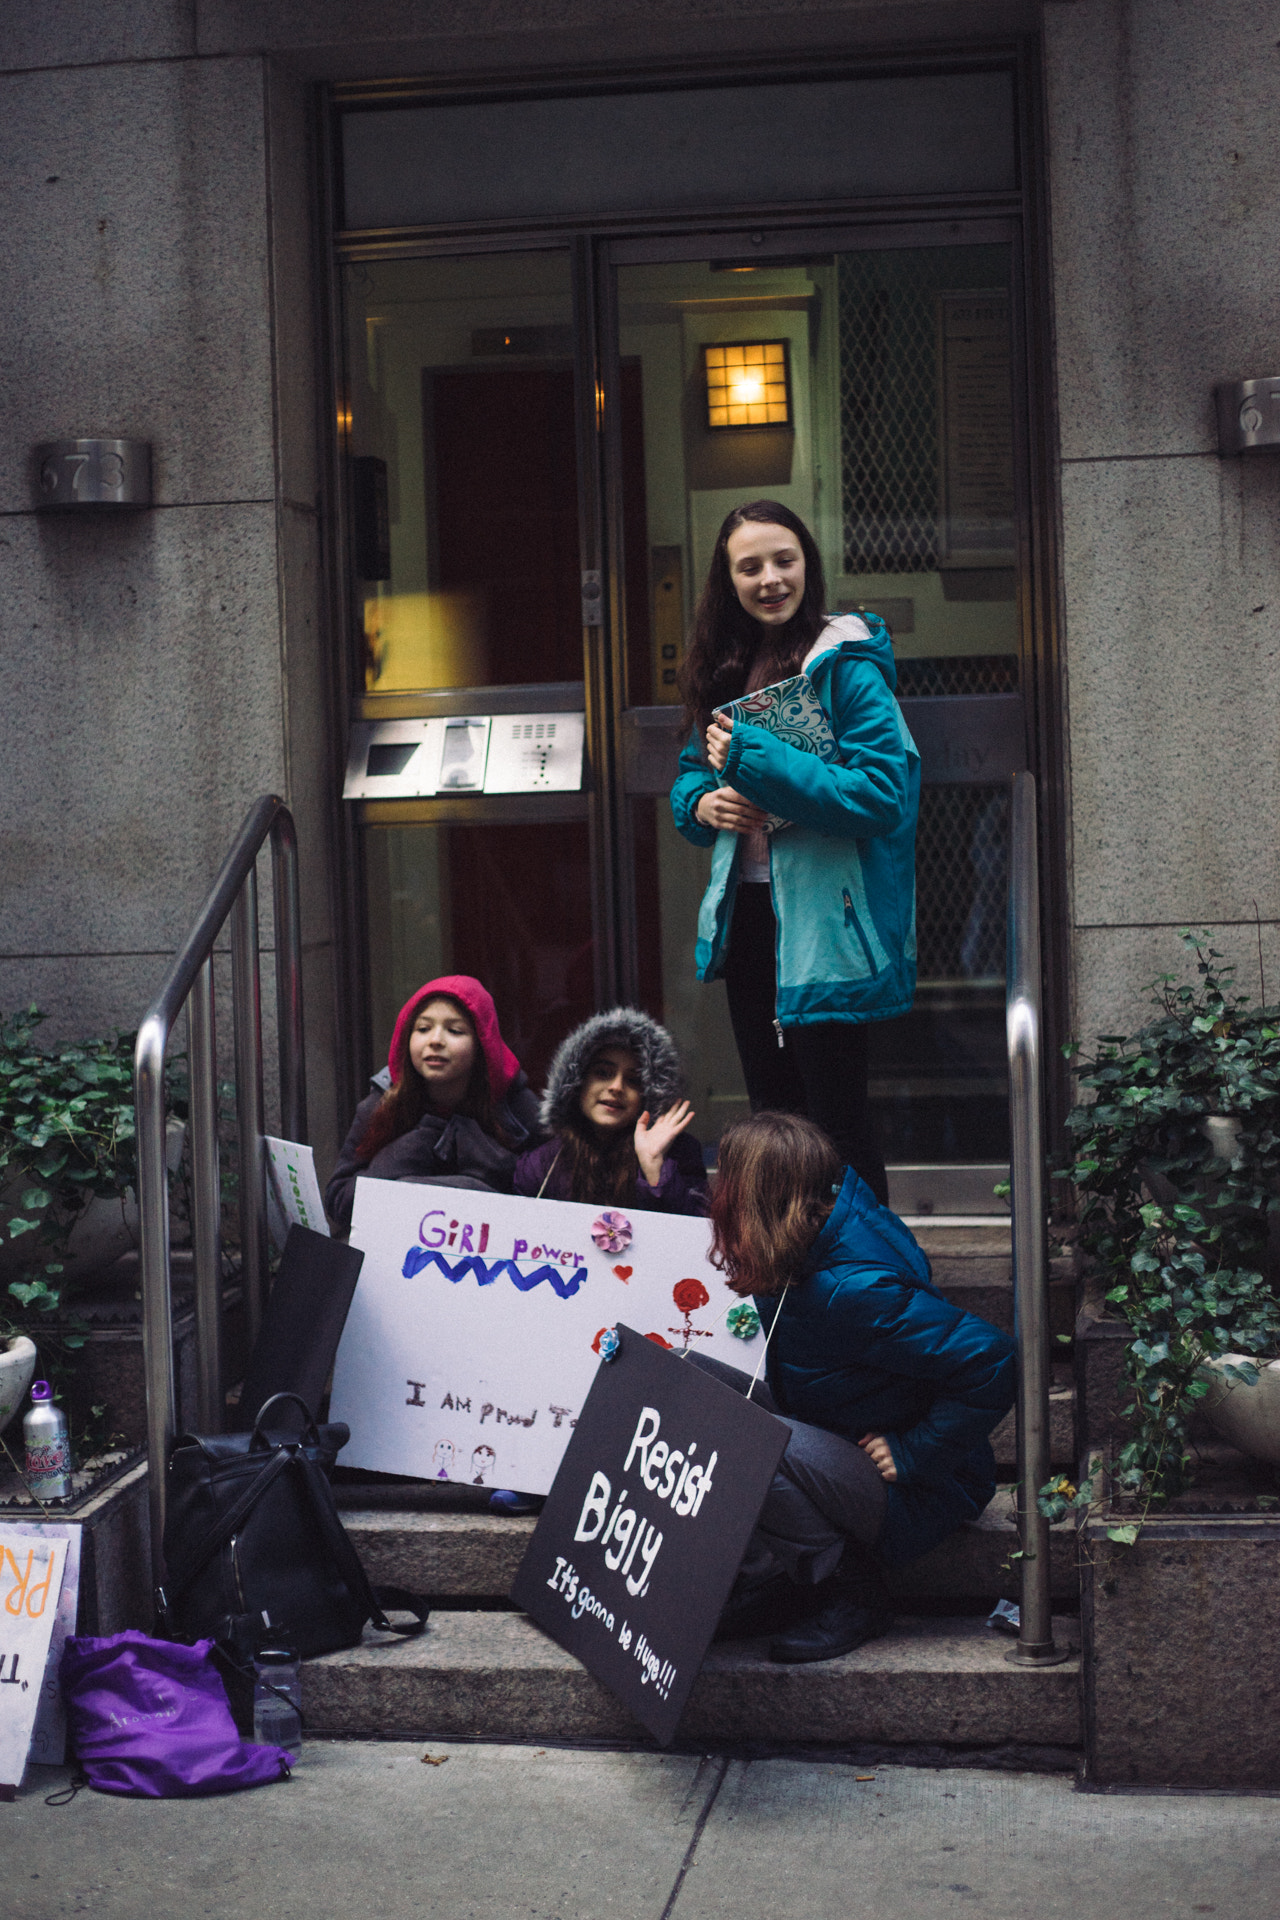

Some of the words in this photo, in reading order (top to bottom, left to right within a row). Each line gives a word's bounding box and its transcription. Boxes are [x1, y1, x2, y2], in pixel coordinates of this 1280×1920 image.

[41, 451, 125, 493] 673
[405, 1379, 426, 1407] I
[440, 1392, 472, 1413] AM
[623, 1406, 718, 1517] Resist
[546, 1556, 580, 1603] It's
[571, 1587, 616, 1632] gonna
[618, 1620, 633, 1651] be
